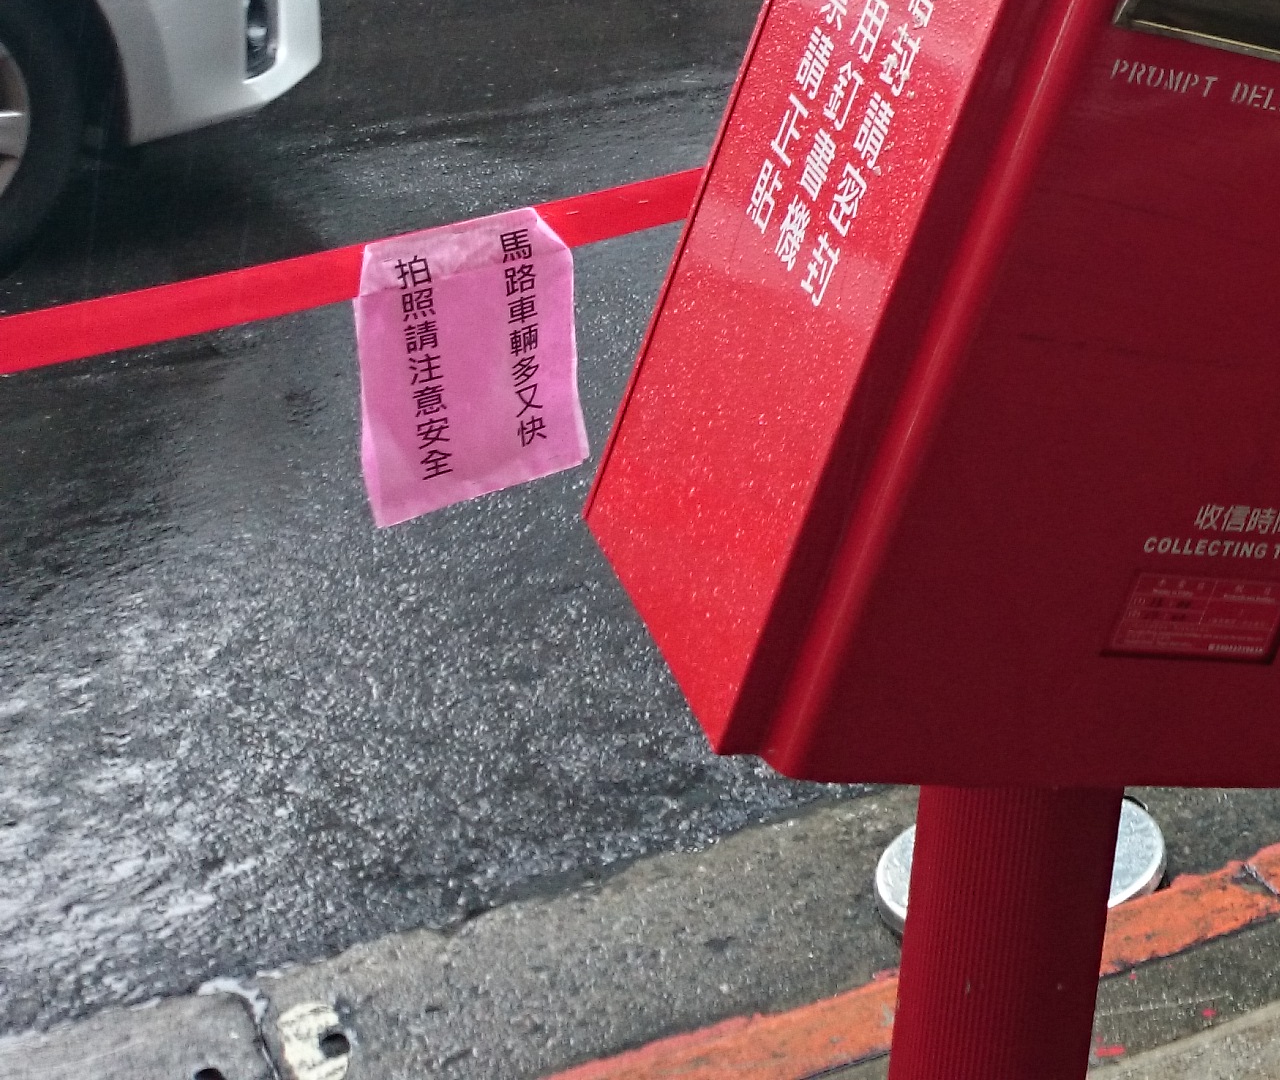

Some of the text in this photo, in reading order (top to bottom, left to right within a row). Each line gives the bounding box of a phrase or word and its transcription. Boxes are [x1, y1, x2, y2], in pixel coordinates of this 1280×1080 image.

[1110, 58, 1218, 98] PROMPT
[394, 254, 454, 481] 拍照請注意安全
[500, 228, 547, 448] 馬路車輛多又快
[1143, 536, 1268, 559] COLLECTING
